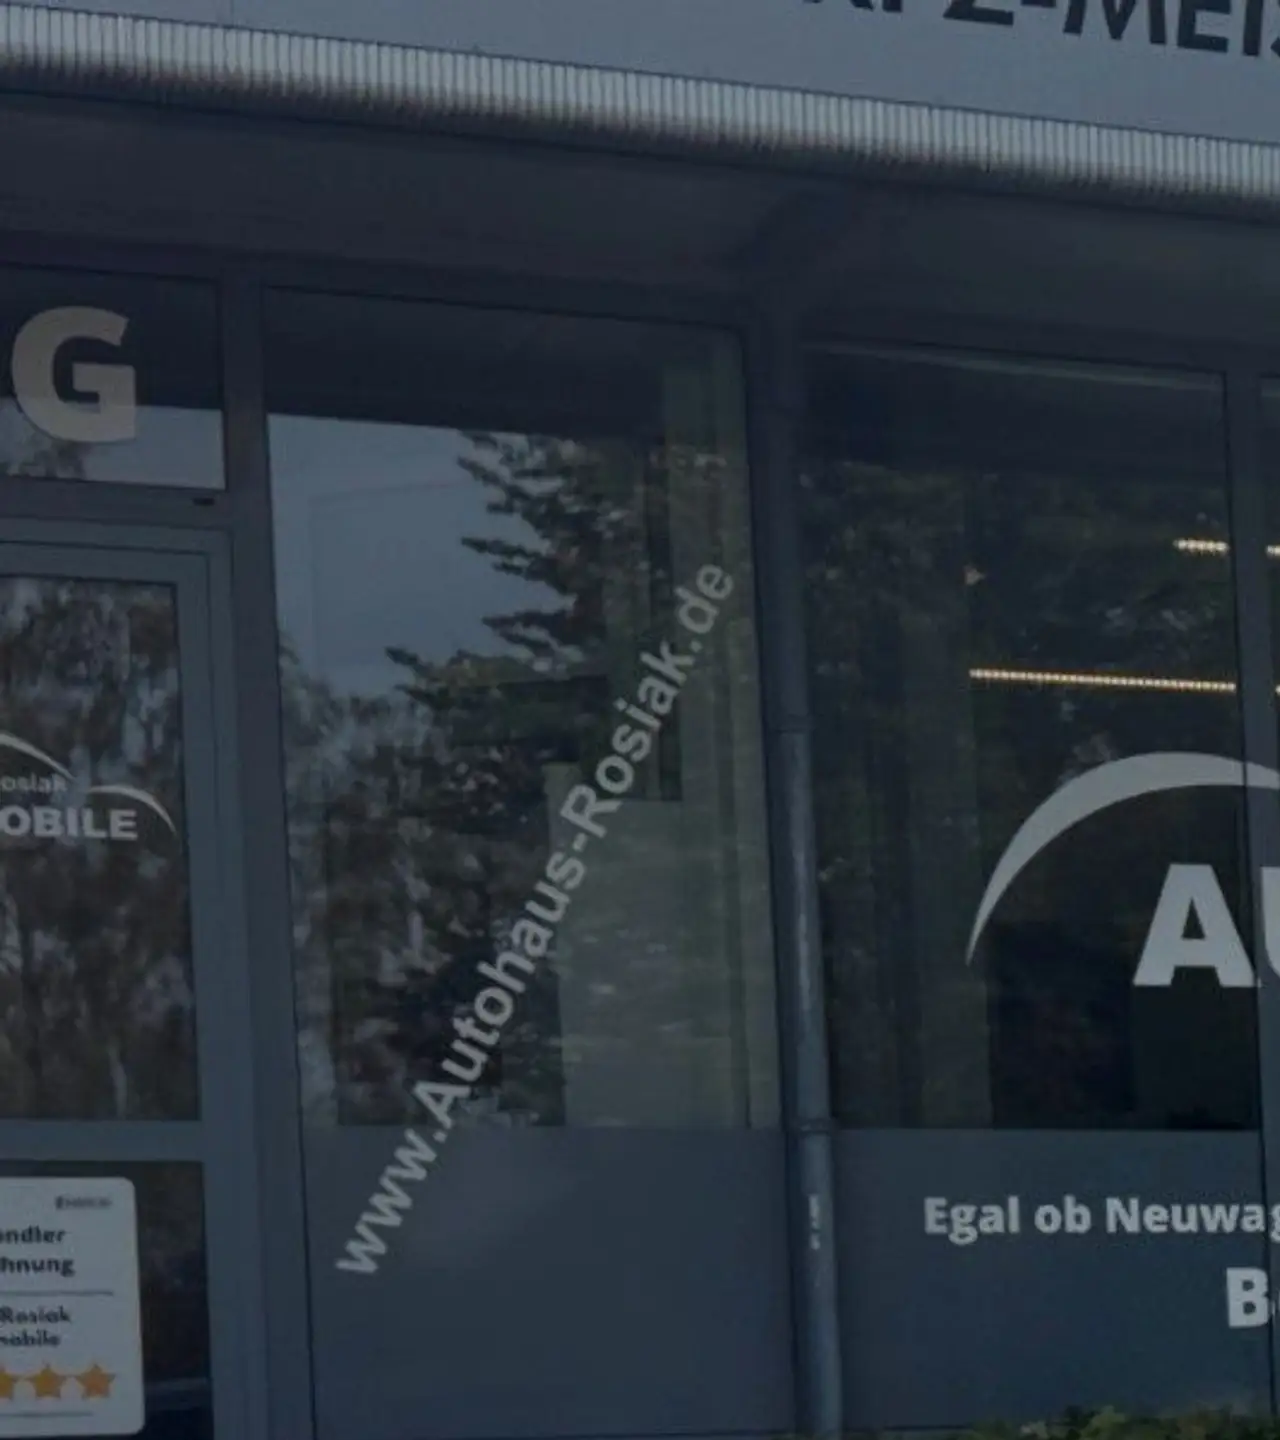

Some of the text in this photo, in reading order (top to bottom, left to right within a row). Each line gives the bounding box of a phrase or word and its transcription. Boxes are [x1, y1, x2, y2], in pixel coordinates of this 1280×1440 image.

[10, 307, 138, 443] G
[336, 562, 734, 1276] www.Autohaus-Rosiak.de
[923, 1195, 1020, 1245] Egal
[1034, 1195, 1092, 1234] ob
